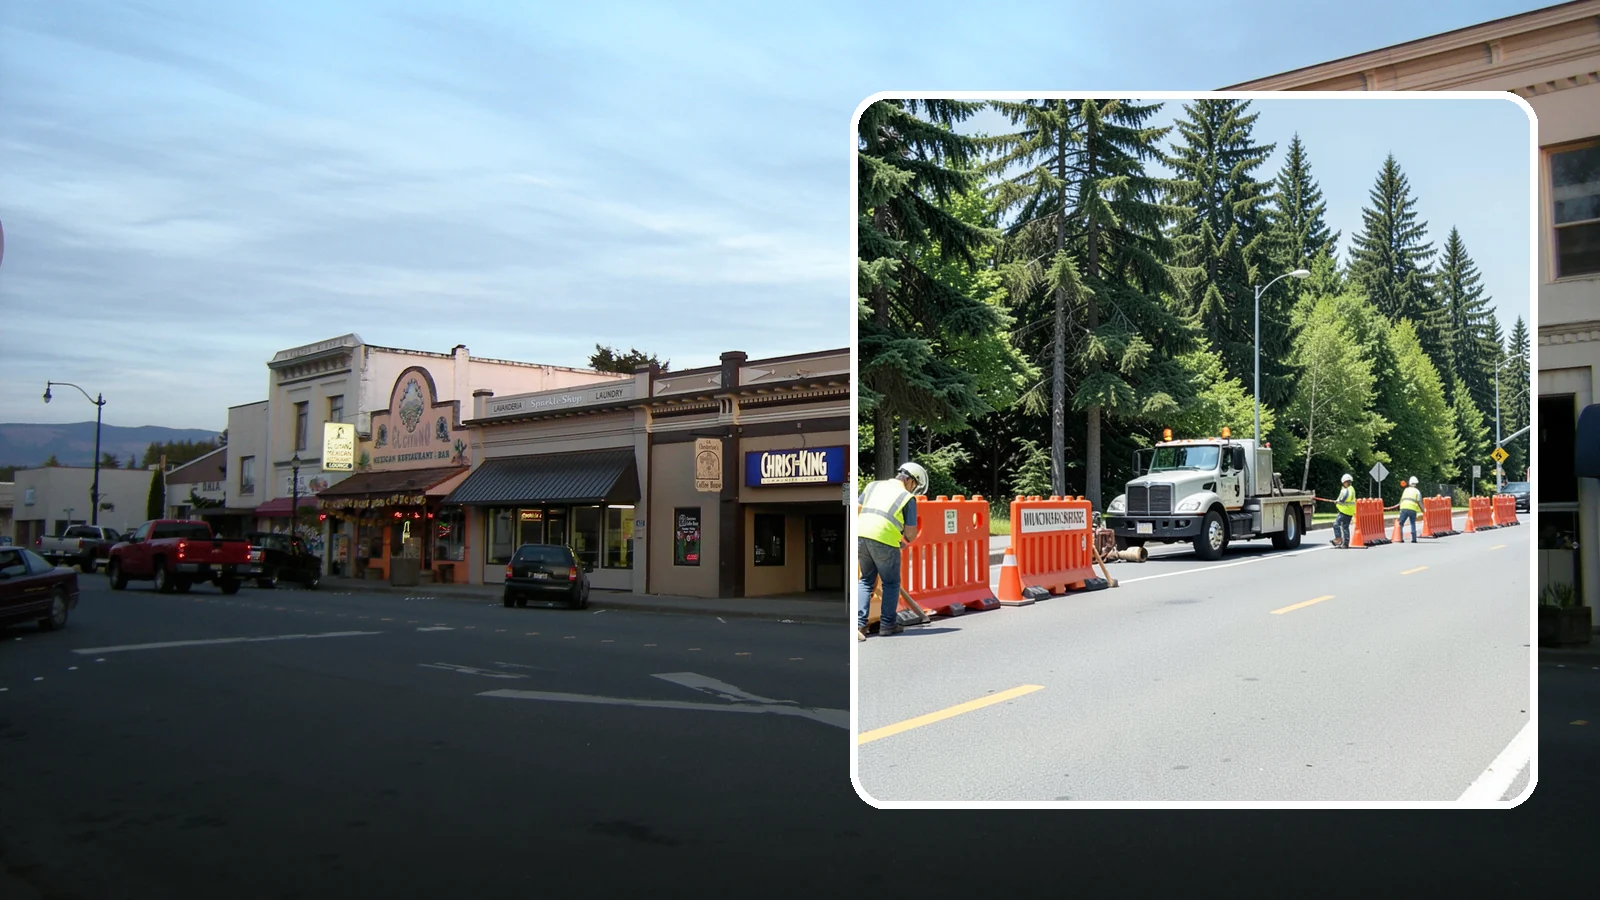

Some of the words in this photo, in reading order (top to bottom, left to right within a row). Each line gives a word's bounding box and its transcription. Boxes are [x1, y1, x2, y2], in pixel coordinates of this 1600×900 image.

[596, 389, 624, 400] LAUNDRY
[494, 402, 523, 412] LAVANDERIA
[531, 397, 561, 408] Sparkle
[562, 394, 582, 405] Shop
[374, 455, 396, 464] MEXICAN
[397, 451, 433, 462] RESTAURANT
[438, 450, 450, 459] BAR
[761, 452, 797, 478] CHRIST
[799, 450, 827, 476] KING
[697, 481, 709, 489] Coffee
